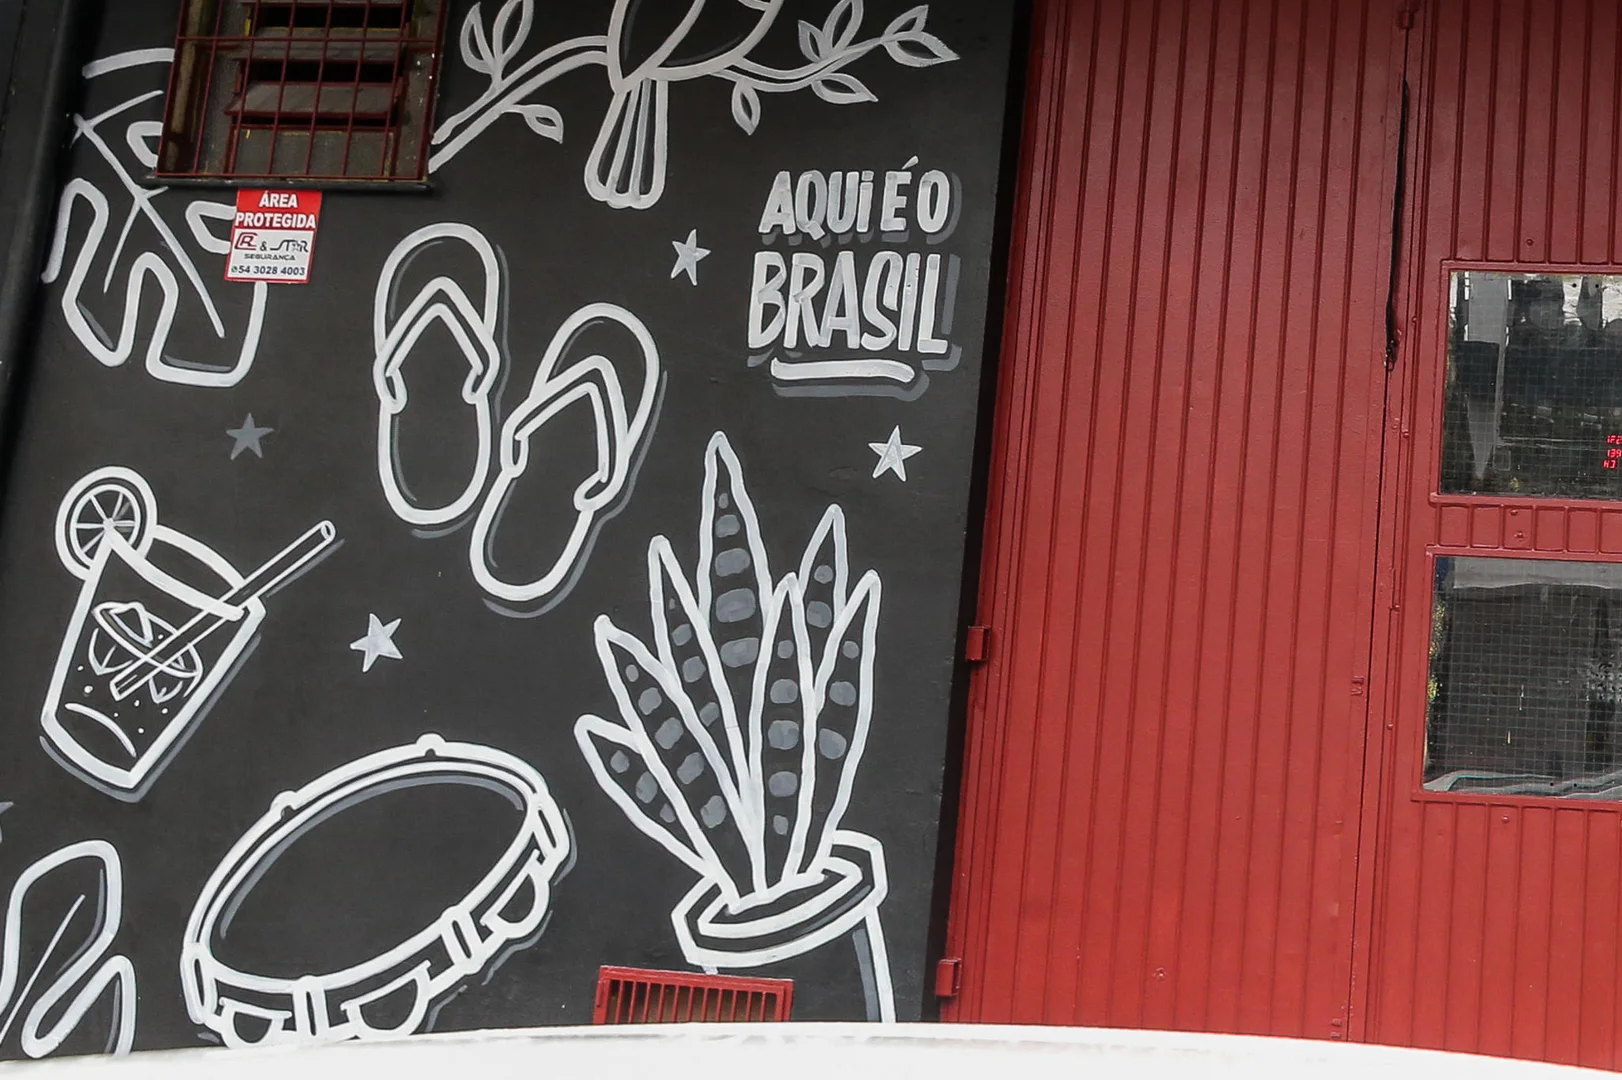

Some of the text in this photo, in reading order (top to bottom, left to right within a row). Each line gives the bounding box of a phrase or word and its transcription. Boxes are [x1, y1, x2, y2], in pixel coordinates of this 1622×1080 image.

[258, 190, 298, 208] ÁREA
[880, 155, 919, 232] É
[916, 170, 950, 233] O
[234, 212, 316, 228] PROTEGIDA
[260, 242, 267, 251] &
[238, 265, 305, 276] 54 3028 4003
[748, 251, 948, 354] BRASIL
